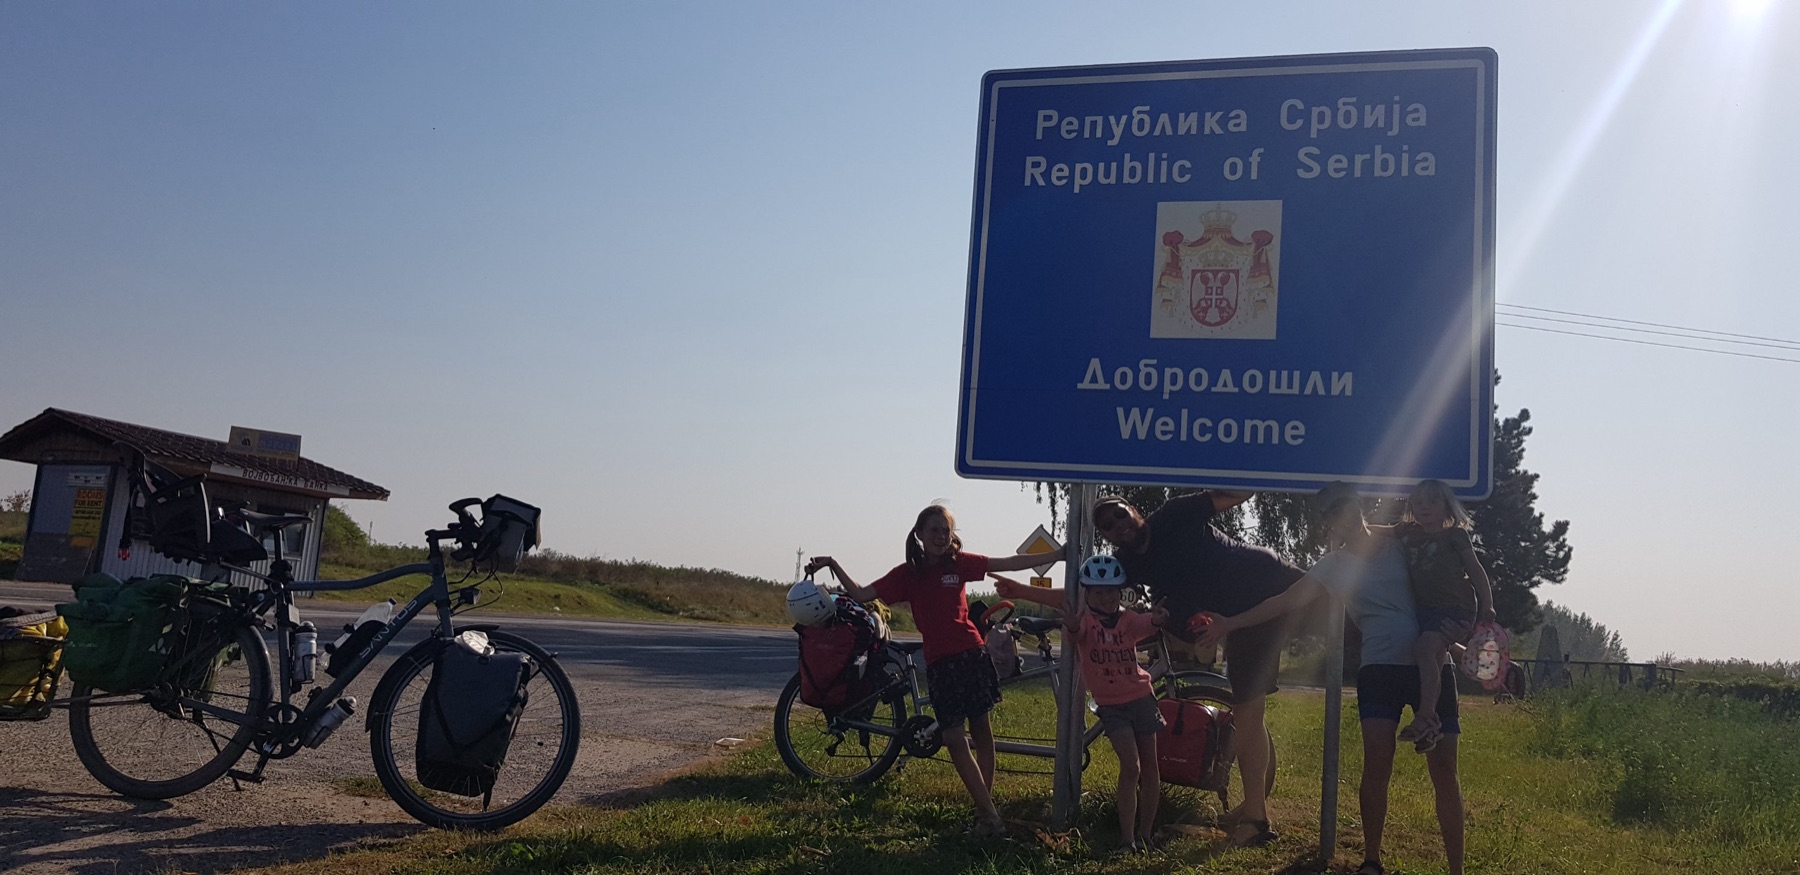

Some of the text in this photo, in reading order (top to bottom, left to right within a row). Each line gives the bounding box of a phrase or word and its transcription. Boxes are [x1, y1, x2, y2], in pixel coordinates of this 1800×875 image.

[1035, 95, 1428, 147] Република Србија
[1023, 145, 1437, 194] Republic of Serbia
[1076, 357, 1354, 400] Добродошли
[1115, 406, 1307, 446] Welcome
[359, 599, 418, 659] SANTOS
